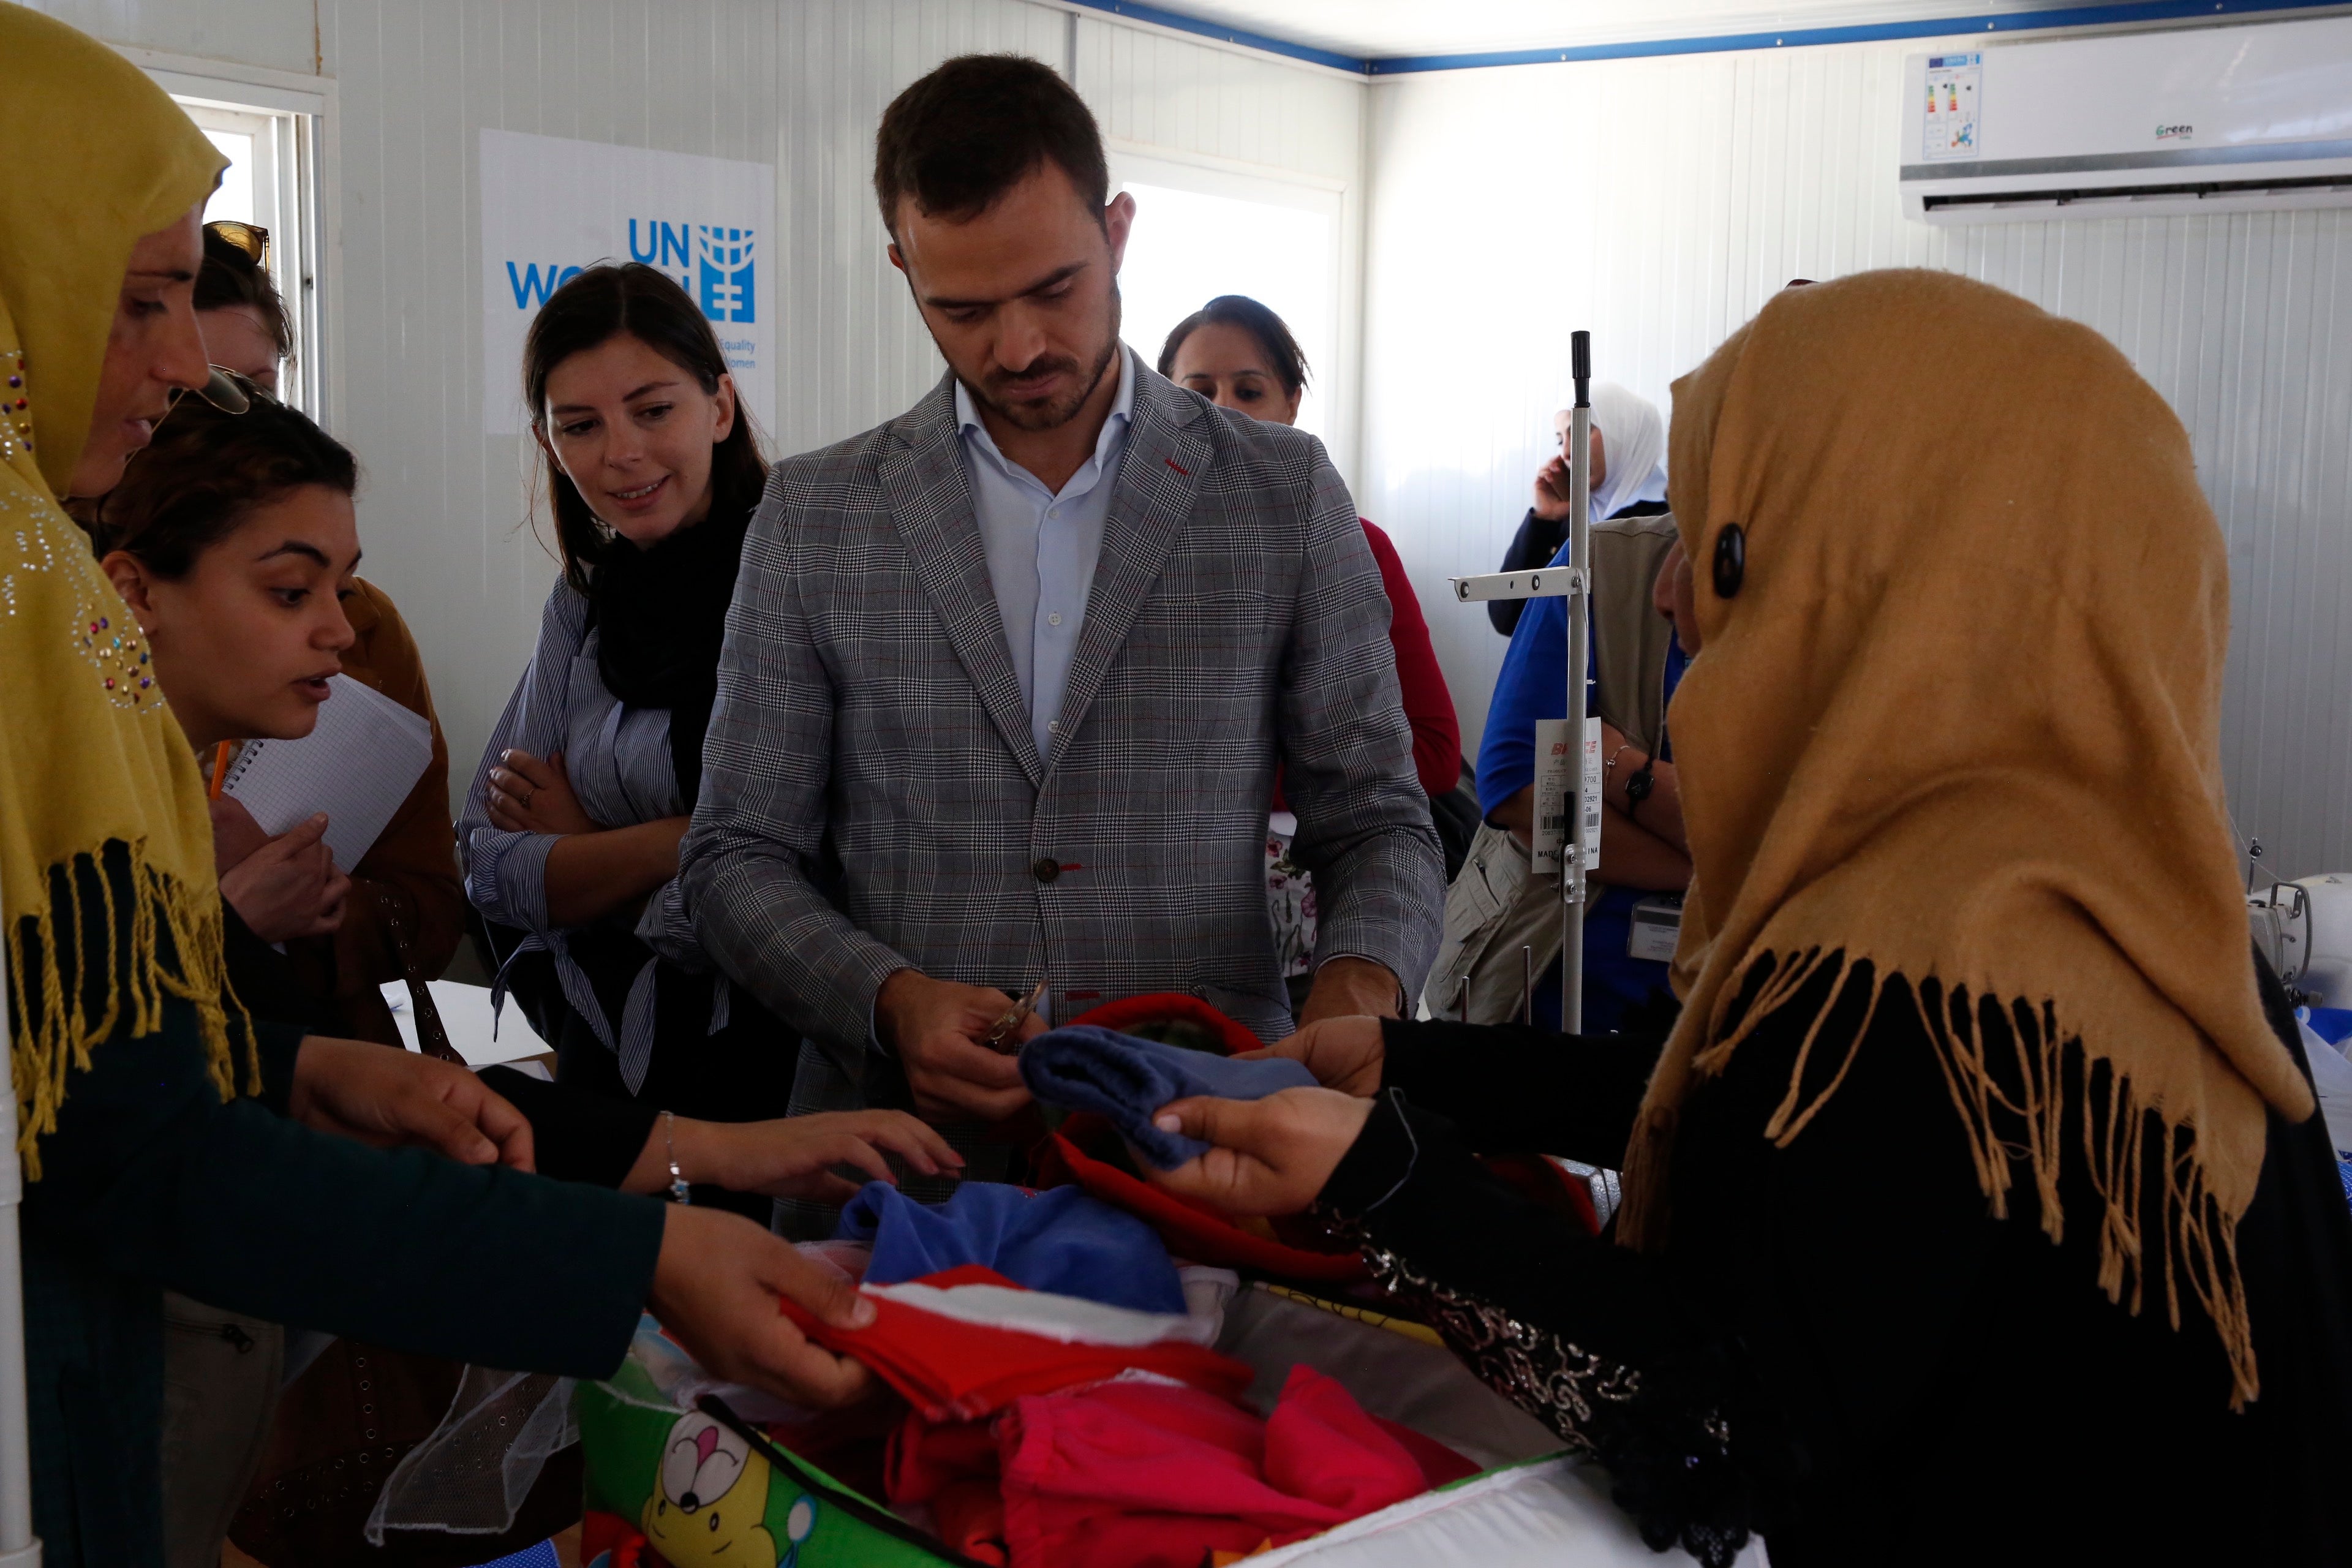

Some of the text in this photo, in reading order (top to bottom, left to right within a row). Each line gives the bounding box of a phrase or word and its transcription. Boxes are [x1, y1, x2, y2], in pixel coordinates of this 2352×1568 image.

[2156, 124, 2193, 135] Green
[628, 219, 689, 268] UN
[1585, 846, 1598, 855] INA
